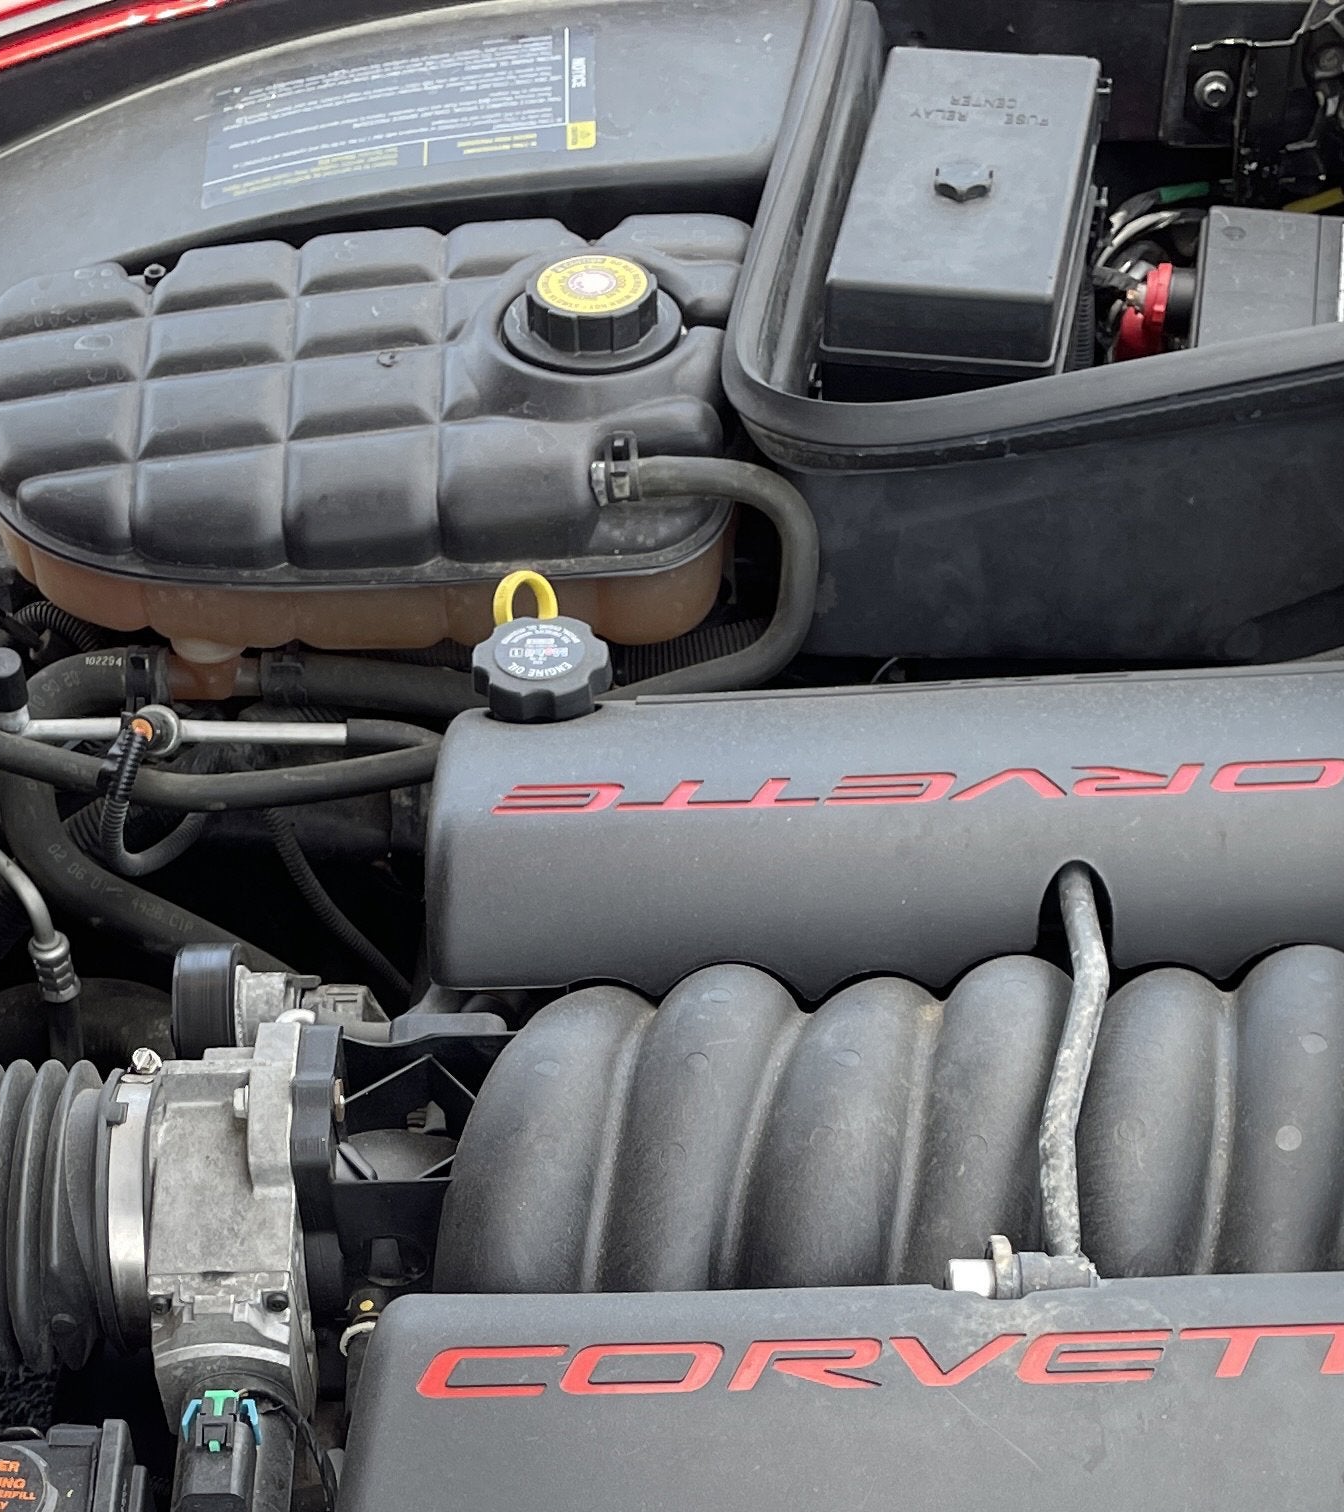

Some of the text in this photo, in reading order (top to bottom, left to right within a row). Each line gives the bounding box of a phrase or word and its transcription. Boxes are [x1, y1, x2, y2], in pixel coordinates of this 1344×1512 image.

[572, 57, 588, 89] NOTICE
[950, 95, 1017, 110] CENTER
[910, 107, 1049, 127] FUSE RELAY
[507, 661, 526, 677] OIL
[527, 661, 573, 677] ENGINE
